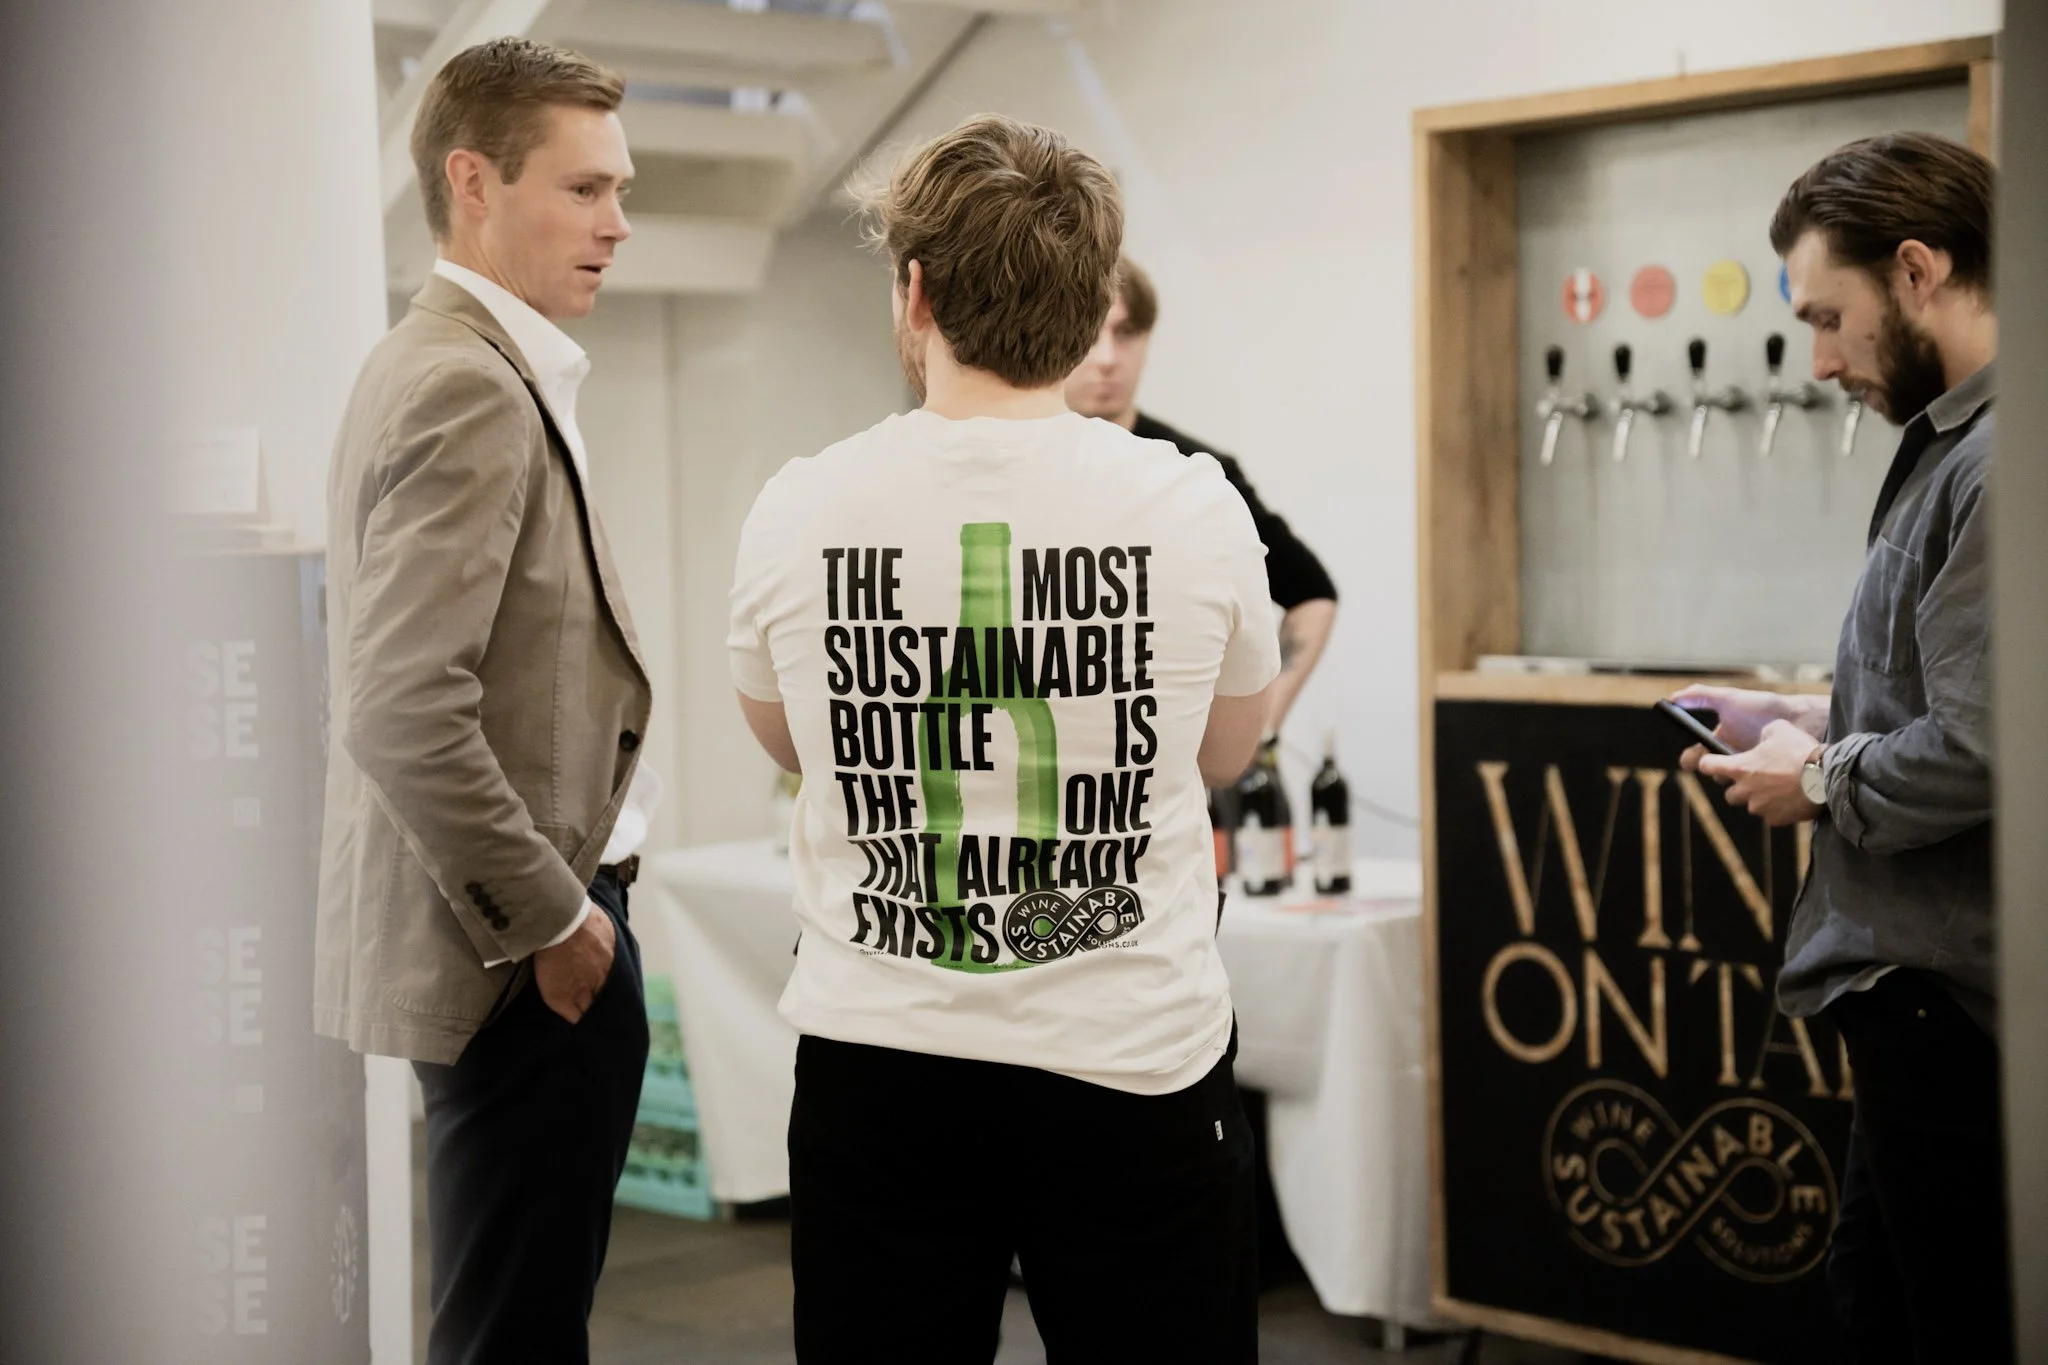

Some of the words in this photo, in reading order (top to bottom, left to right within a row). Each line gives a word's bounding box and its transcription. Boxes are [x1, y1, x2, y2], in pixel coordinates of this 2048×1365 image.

[822, 547, 903, 621] THE
[1022, 545, 1152, 621] MOST
[824, 622, 1155, 699] SUSTAINABLE
[829, 698, 995, 771] BOTTLE
[1114, 694, 1158, 768] IS
[834, 771, 920, 837] THE
[1065, 768, 1154, 835] ONE
[847, 832, 942, 903] THAT
[956, 834, 1152, 901] ALREADY
[1475, 760, 1812, 952] WIN
[849, 891, 1000, 965] EXISTS
[1010, 891, 1136, 959] SUSTAINABLE
[1017, 898, 1061, 918] WINE
[1482, 941, 1669, 1080] ON
[1569, 1100, 1658, 1145] WINE
[1553, 1112, 1827, 1252] SUSTAINABLE
